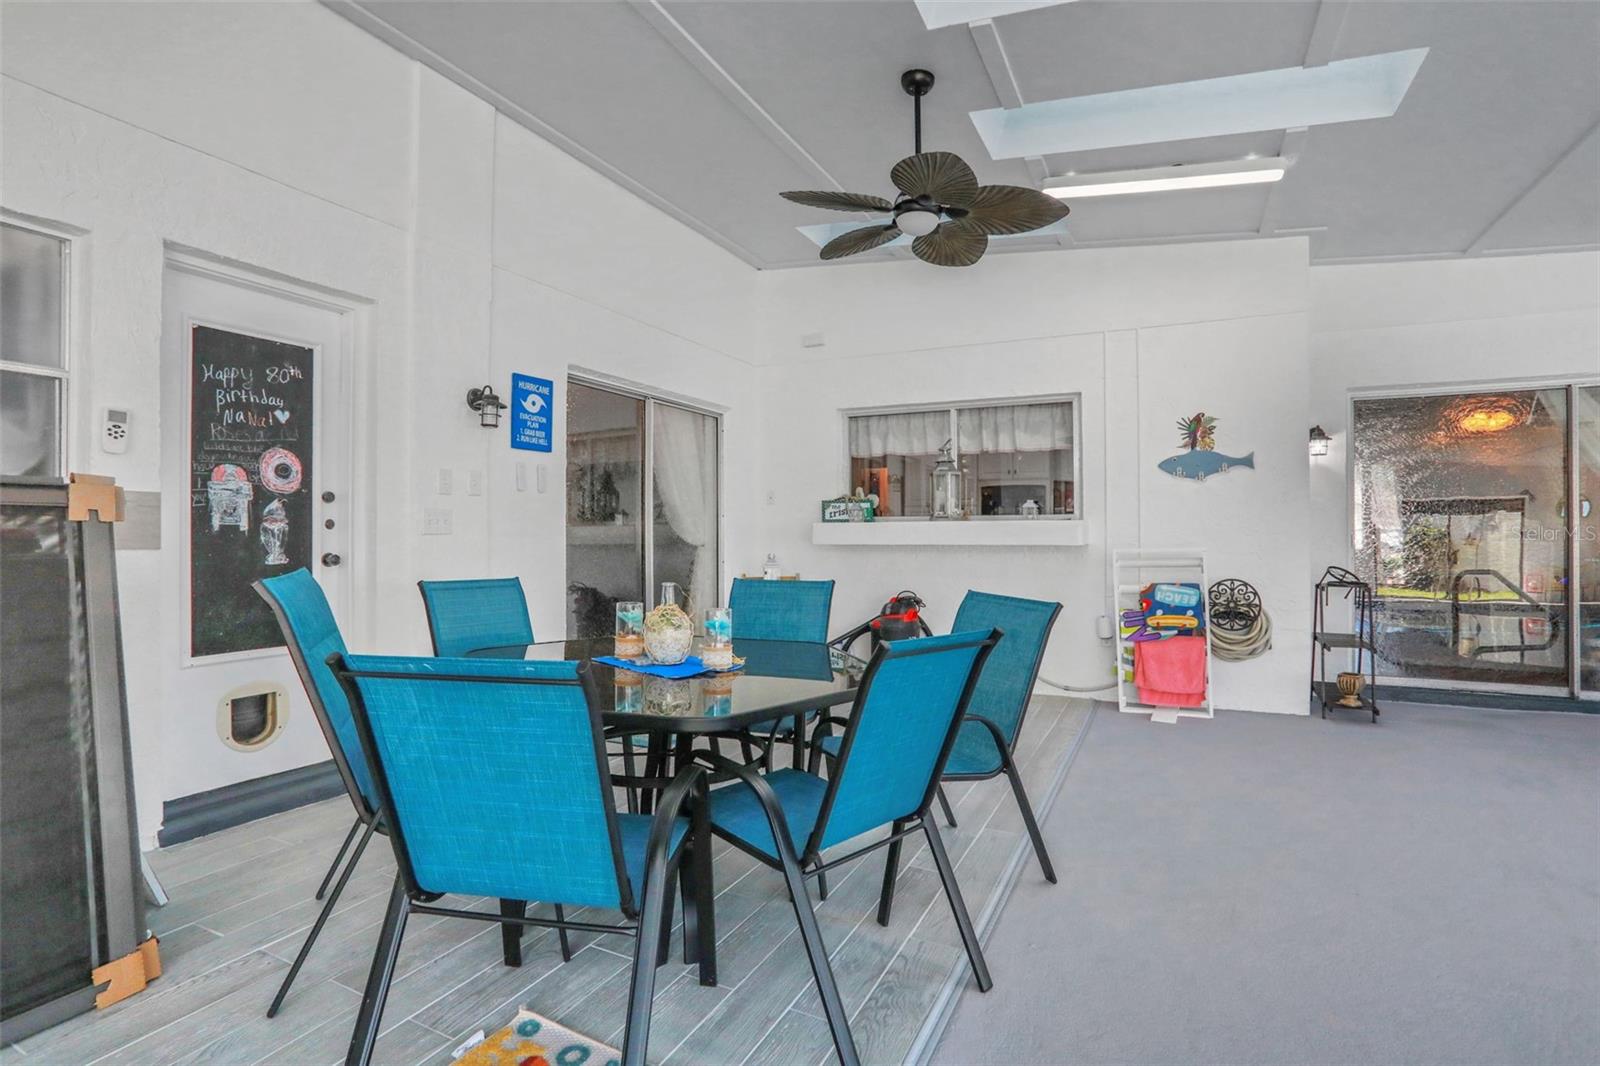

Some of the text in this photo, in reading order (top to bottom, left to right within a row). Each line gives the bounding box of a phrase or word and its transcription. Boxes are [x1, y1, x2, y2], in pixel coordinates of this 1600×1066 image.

[202, 363, 303, 390] Happy 80th
[518, 381, 550, 395] HURRICANE
[216, 388, 284, 413] Birthday
[519, 413, 547, 424] EVACUATION
[527, 421, 539, 429] PLAN
